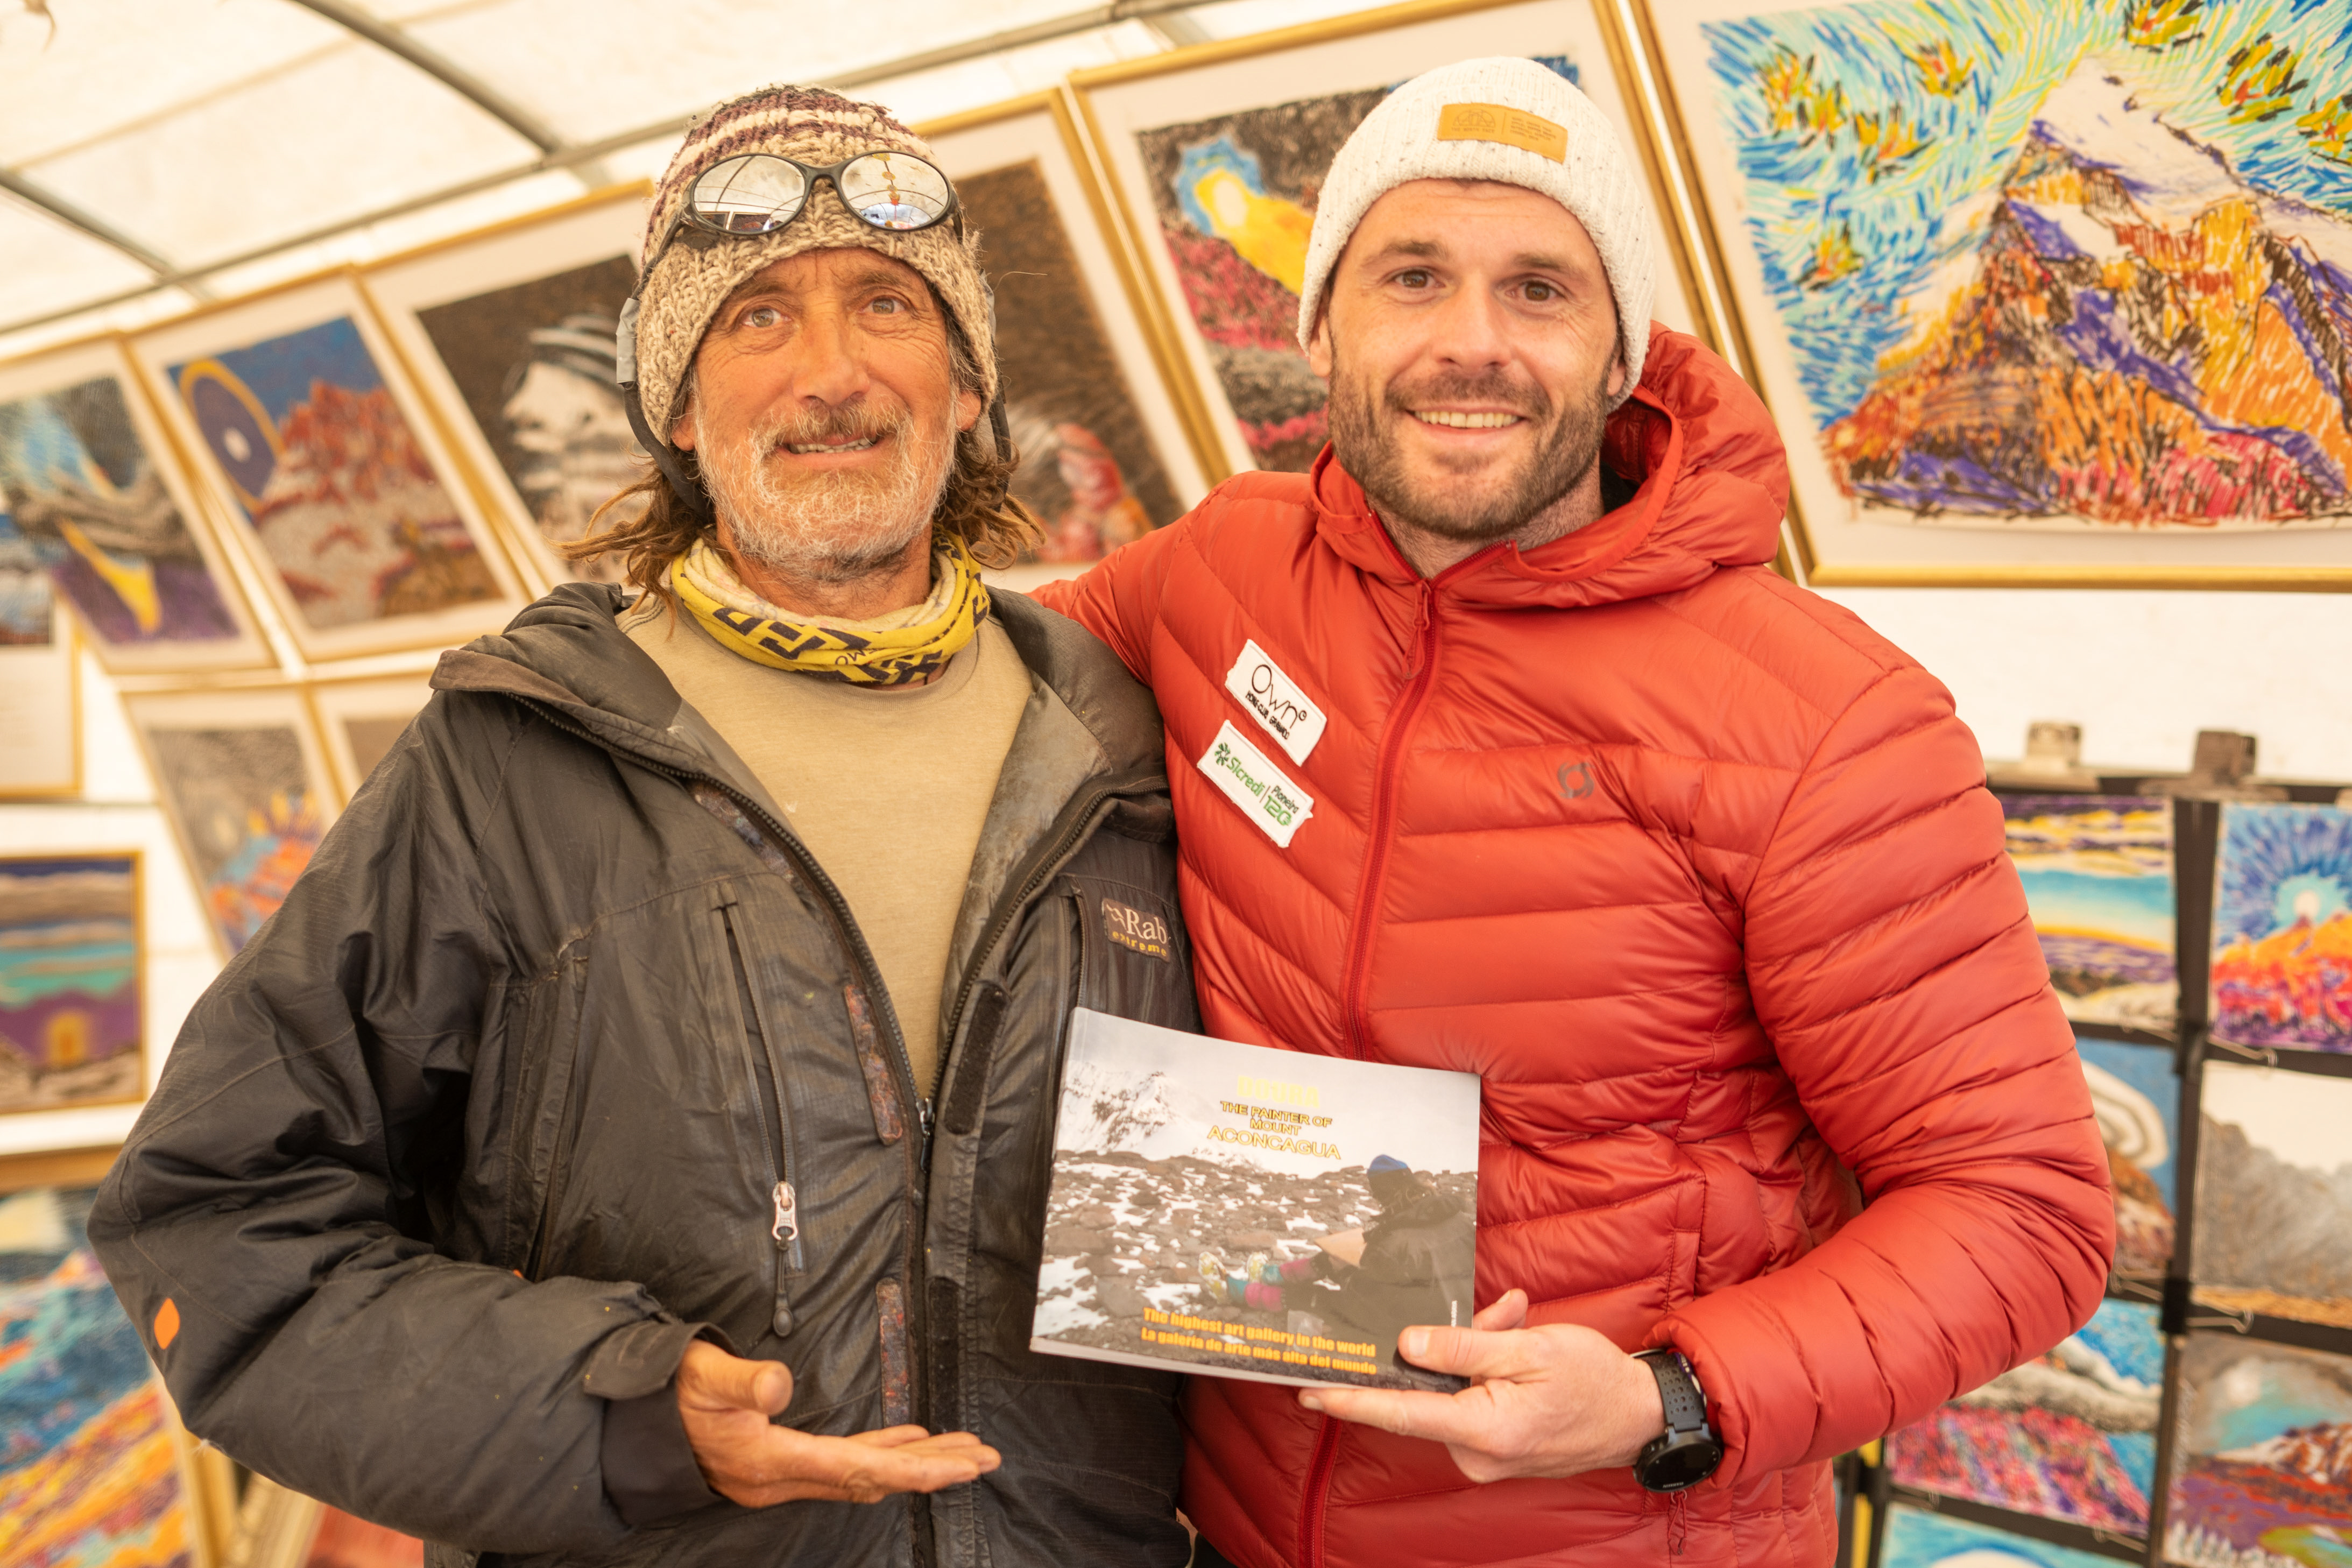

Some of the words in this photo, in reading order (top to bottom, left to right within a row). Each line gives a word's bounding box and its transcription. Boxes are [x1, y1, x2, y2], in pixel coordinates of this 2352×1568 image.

[1226, 757, 1265, 796] Sicredi
[1271, 785, 1299, 814] Pioneira
[1125, 908, 1167, 944] Rab
[1112, 931, 1167, 956] extreme
[1238, 1077, 1319, 1107] DOURA
[1220, 1100, 1248, 1115] THE
[1251, 1106, 1310, 1125] PAINTER
[1312, 1116, 1332, 1127] OF
[1250, 1118, 1302, 1136] MOUNT
[1207, 1125, 1341, 1160] ACONCAGUA
[1143, 1307, 1168, 1324] The
[1170, 1312, 1223, 1333] highest
[1224, 1323, 1244, 1337] art
[1246, 1326, 1295, 1346] gallery
[1296, 1333, 1310, 1347] in
[1312, 1336, 1335, 1351] the
[1337, 1340, 1376, 1357] world
[1141, 1327, 1156, 1341] La
[1205, 1338, 1223, 1352] de
[1224, 1342, 1251, 1357] arte
[1253, 1346, 1280, 1361] más
[1282, 1350, 1308, 1365] alta
[1309, 1354, 1330, 1368] del
[1332, 1358, 1376, 1375] mundo
